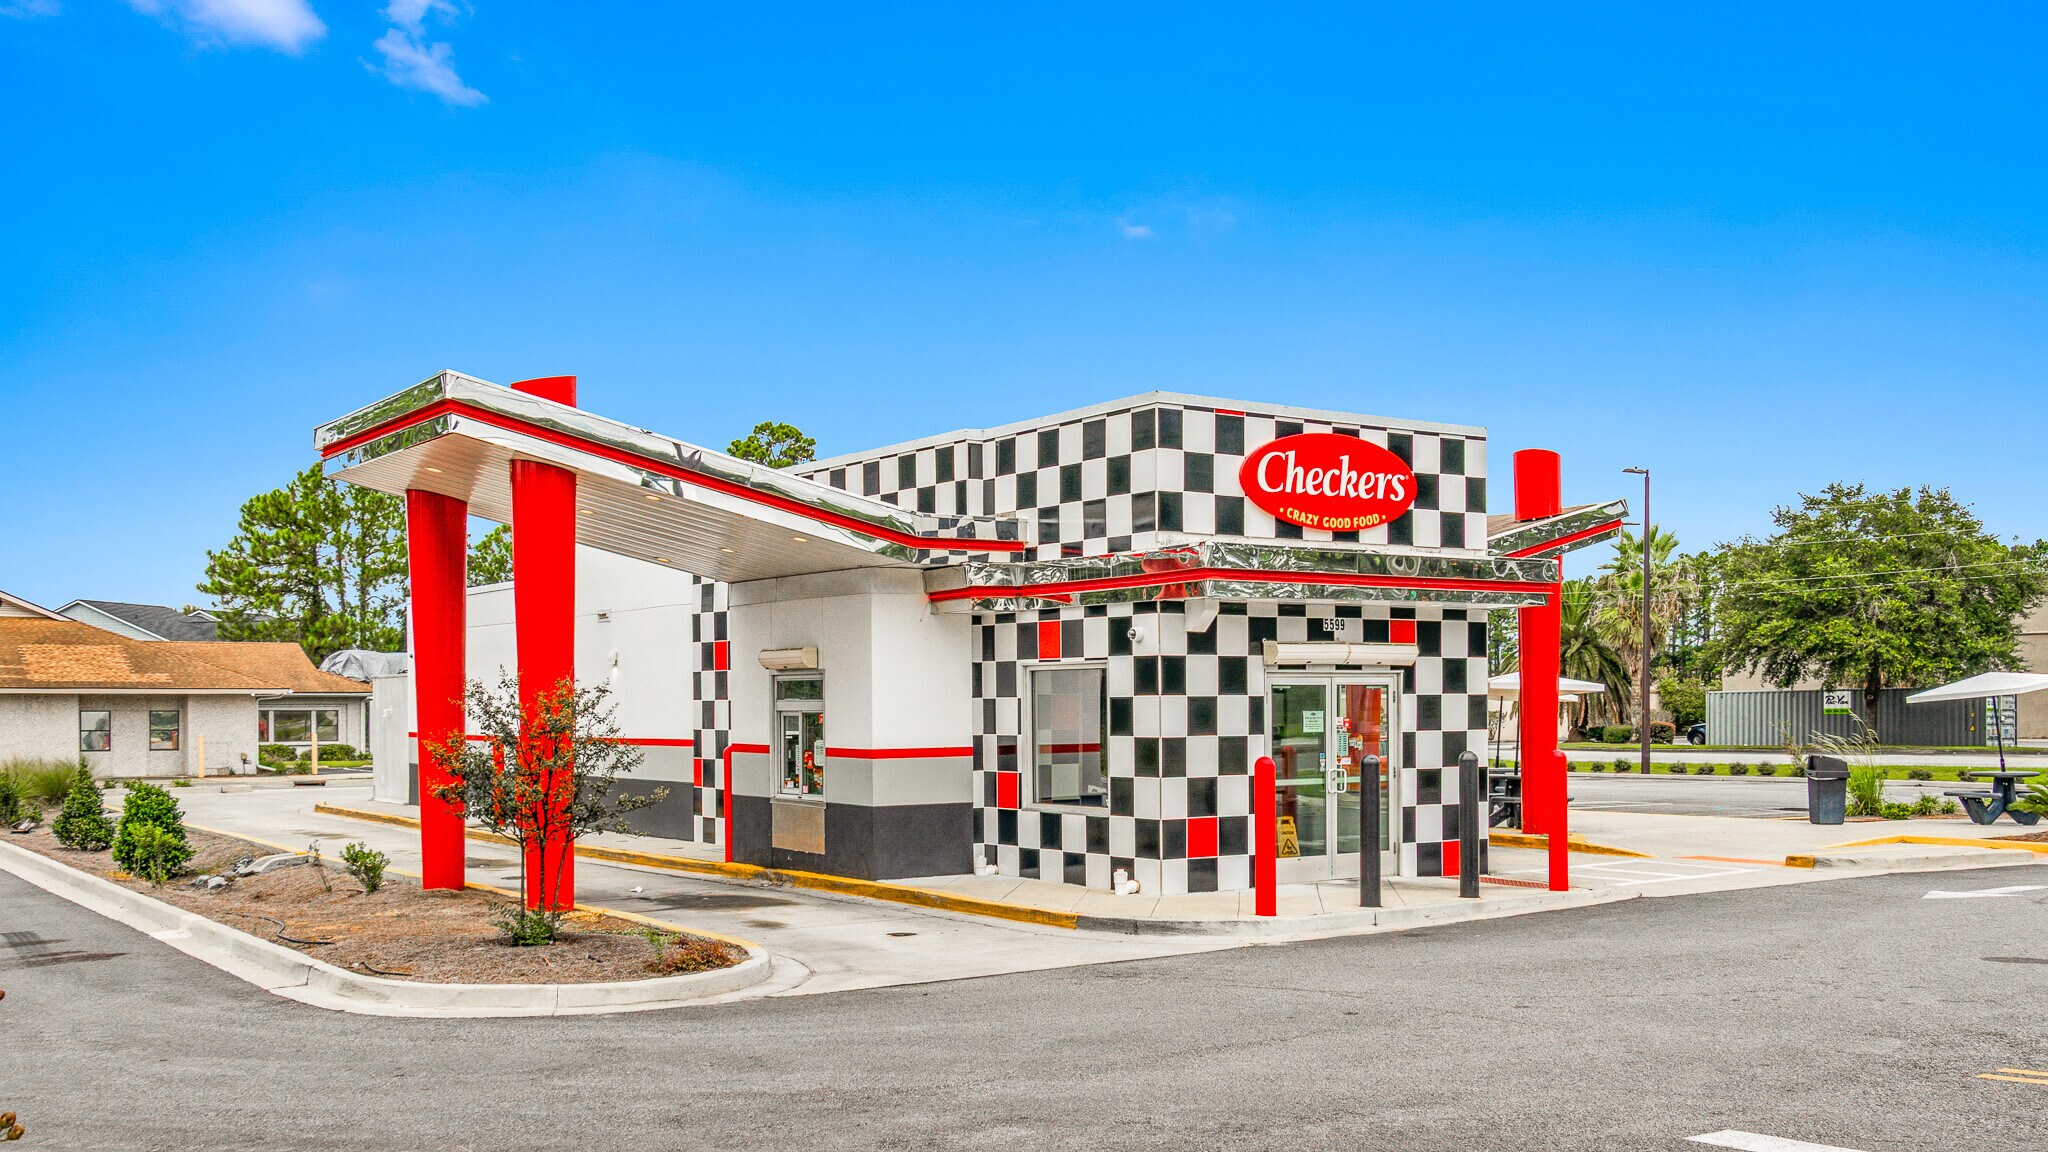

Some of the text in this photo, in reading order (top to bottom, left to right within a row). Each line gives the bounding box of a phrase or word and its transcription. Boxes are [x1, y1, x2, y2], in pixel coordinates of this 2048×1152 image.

[1257, 450, 1406, 502] Checkers
[1286, 507, 1380, 529] CRAZY GOOD FOOD
[1324, 618, 1345, 631] 5599
